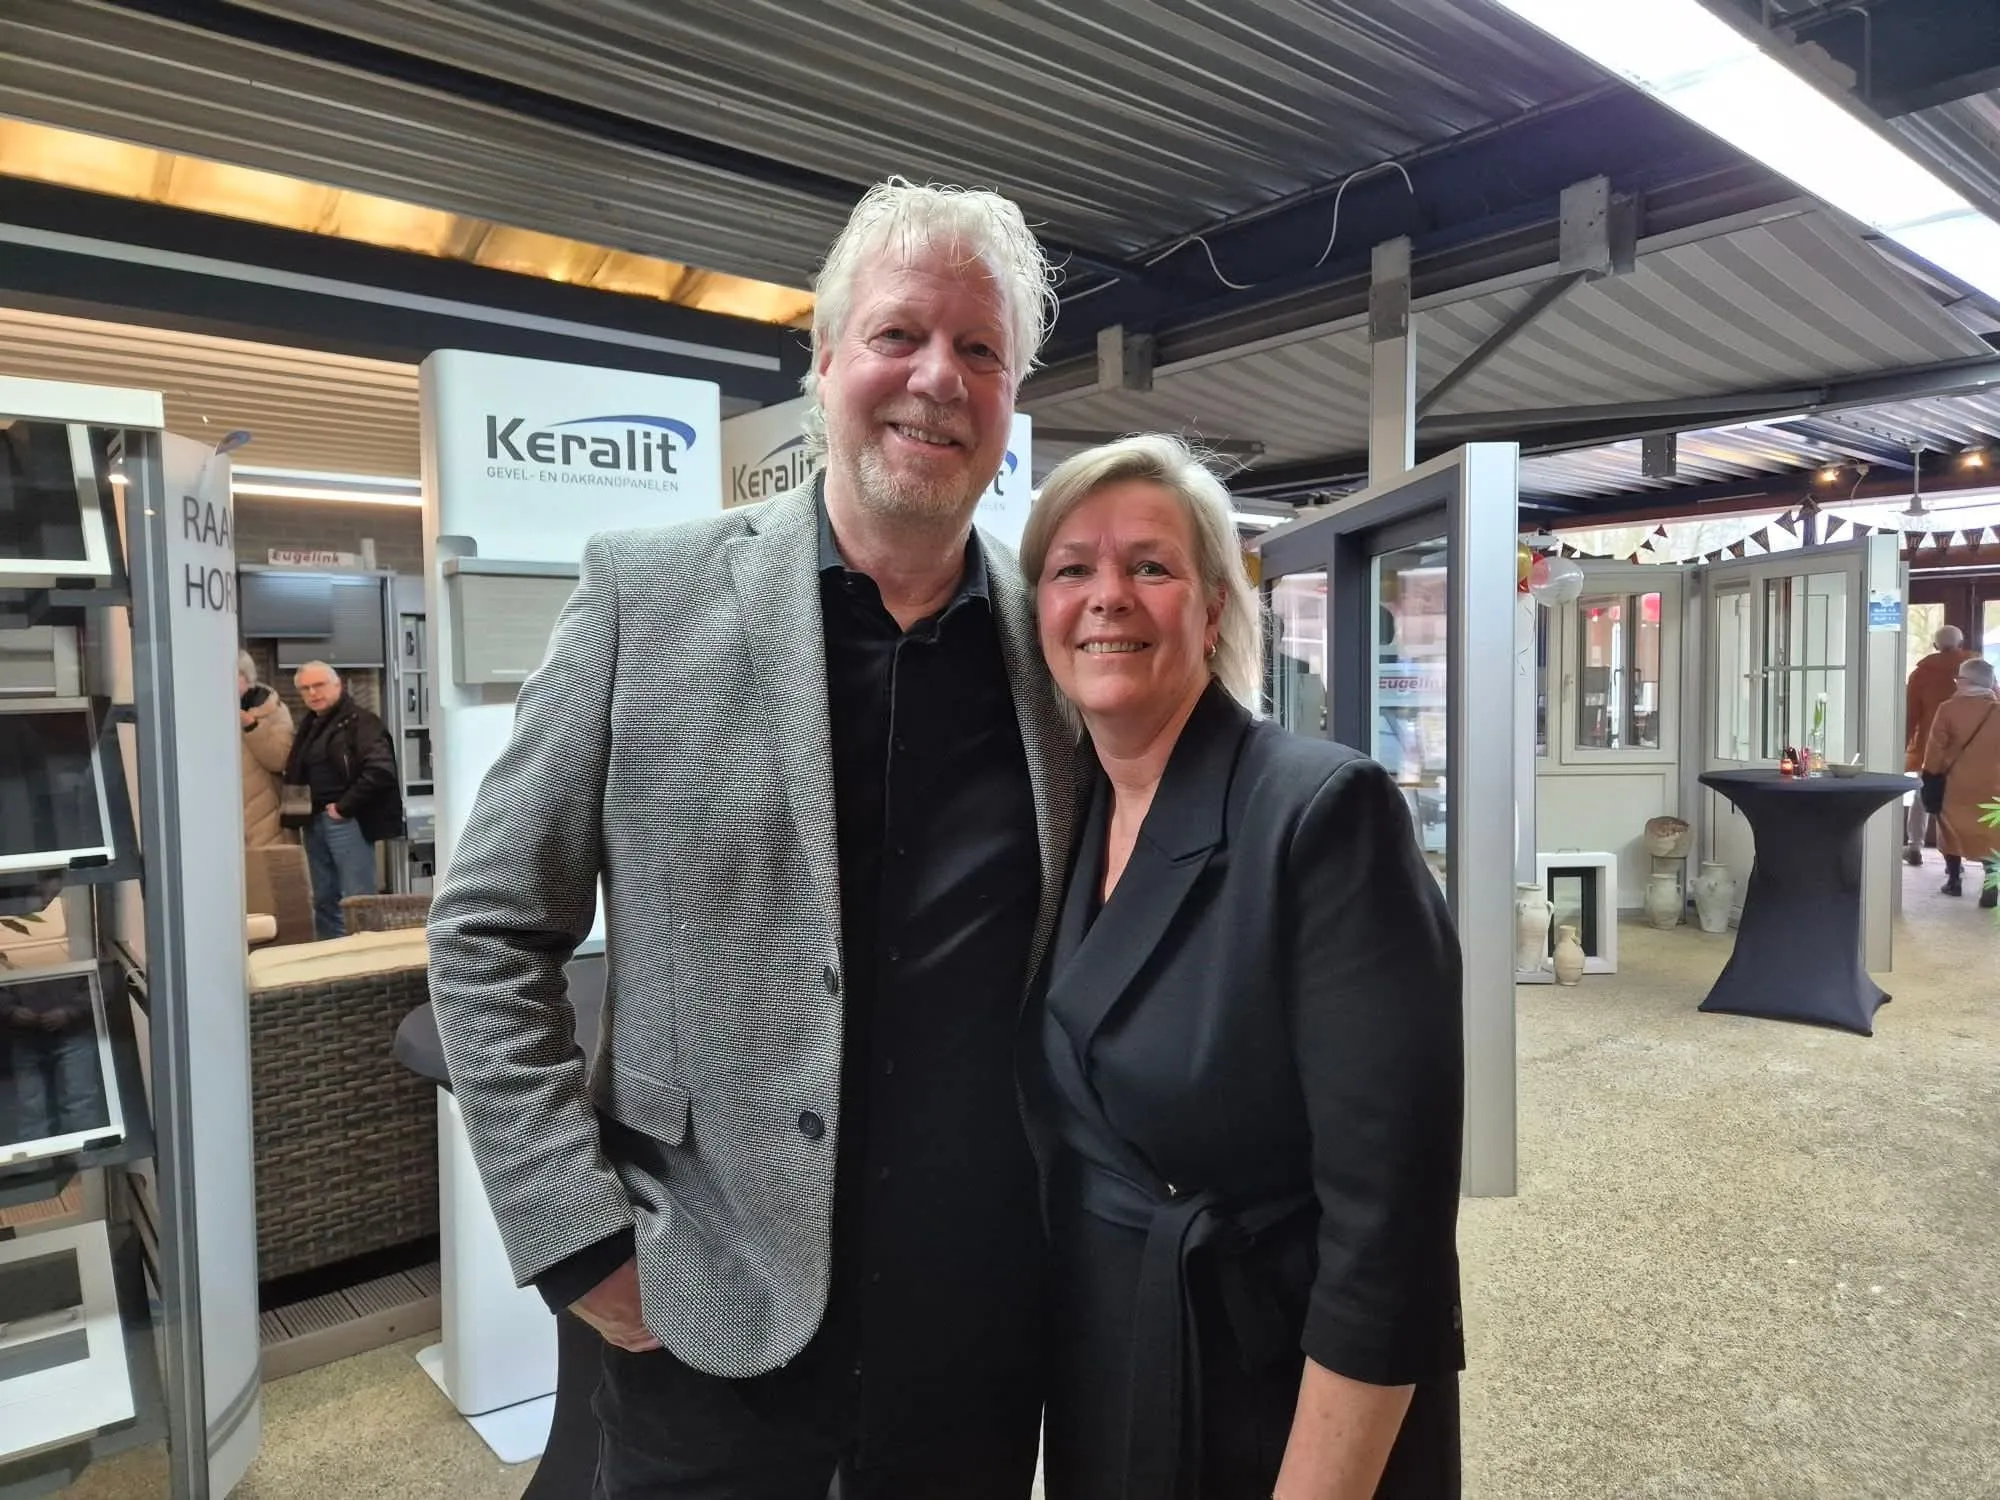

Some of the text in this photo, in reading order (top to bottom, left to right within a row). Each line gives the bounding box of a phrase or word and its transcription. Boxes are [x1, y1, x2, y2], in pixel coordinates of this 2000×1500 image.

[486, 414, 678, 475] Keralit
[486, 465, 679, 493] GEVEL- EN DAKRANDPANELEN
[183, 495, 233, 549] RAA
[185, 563, 238, 613] HOR
